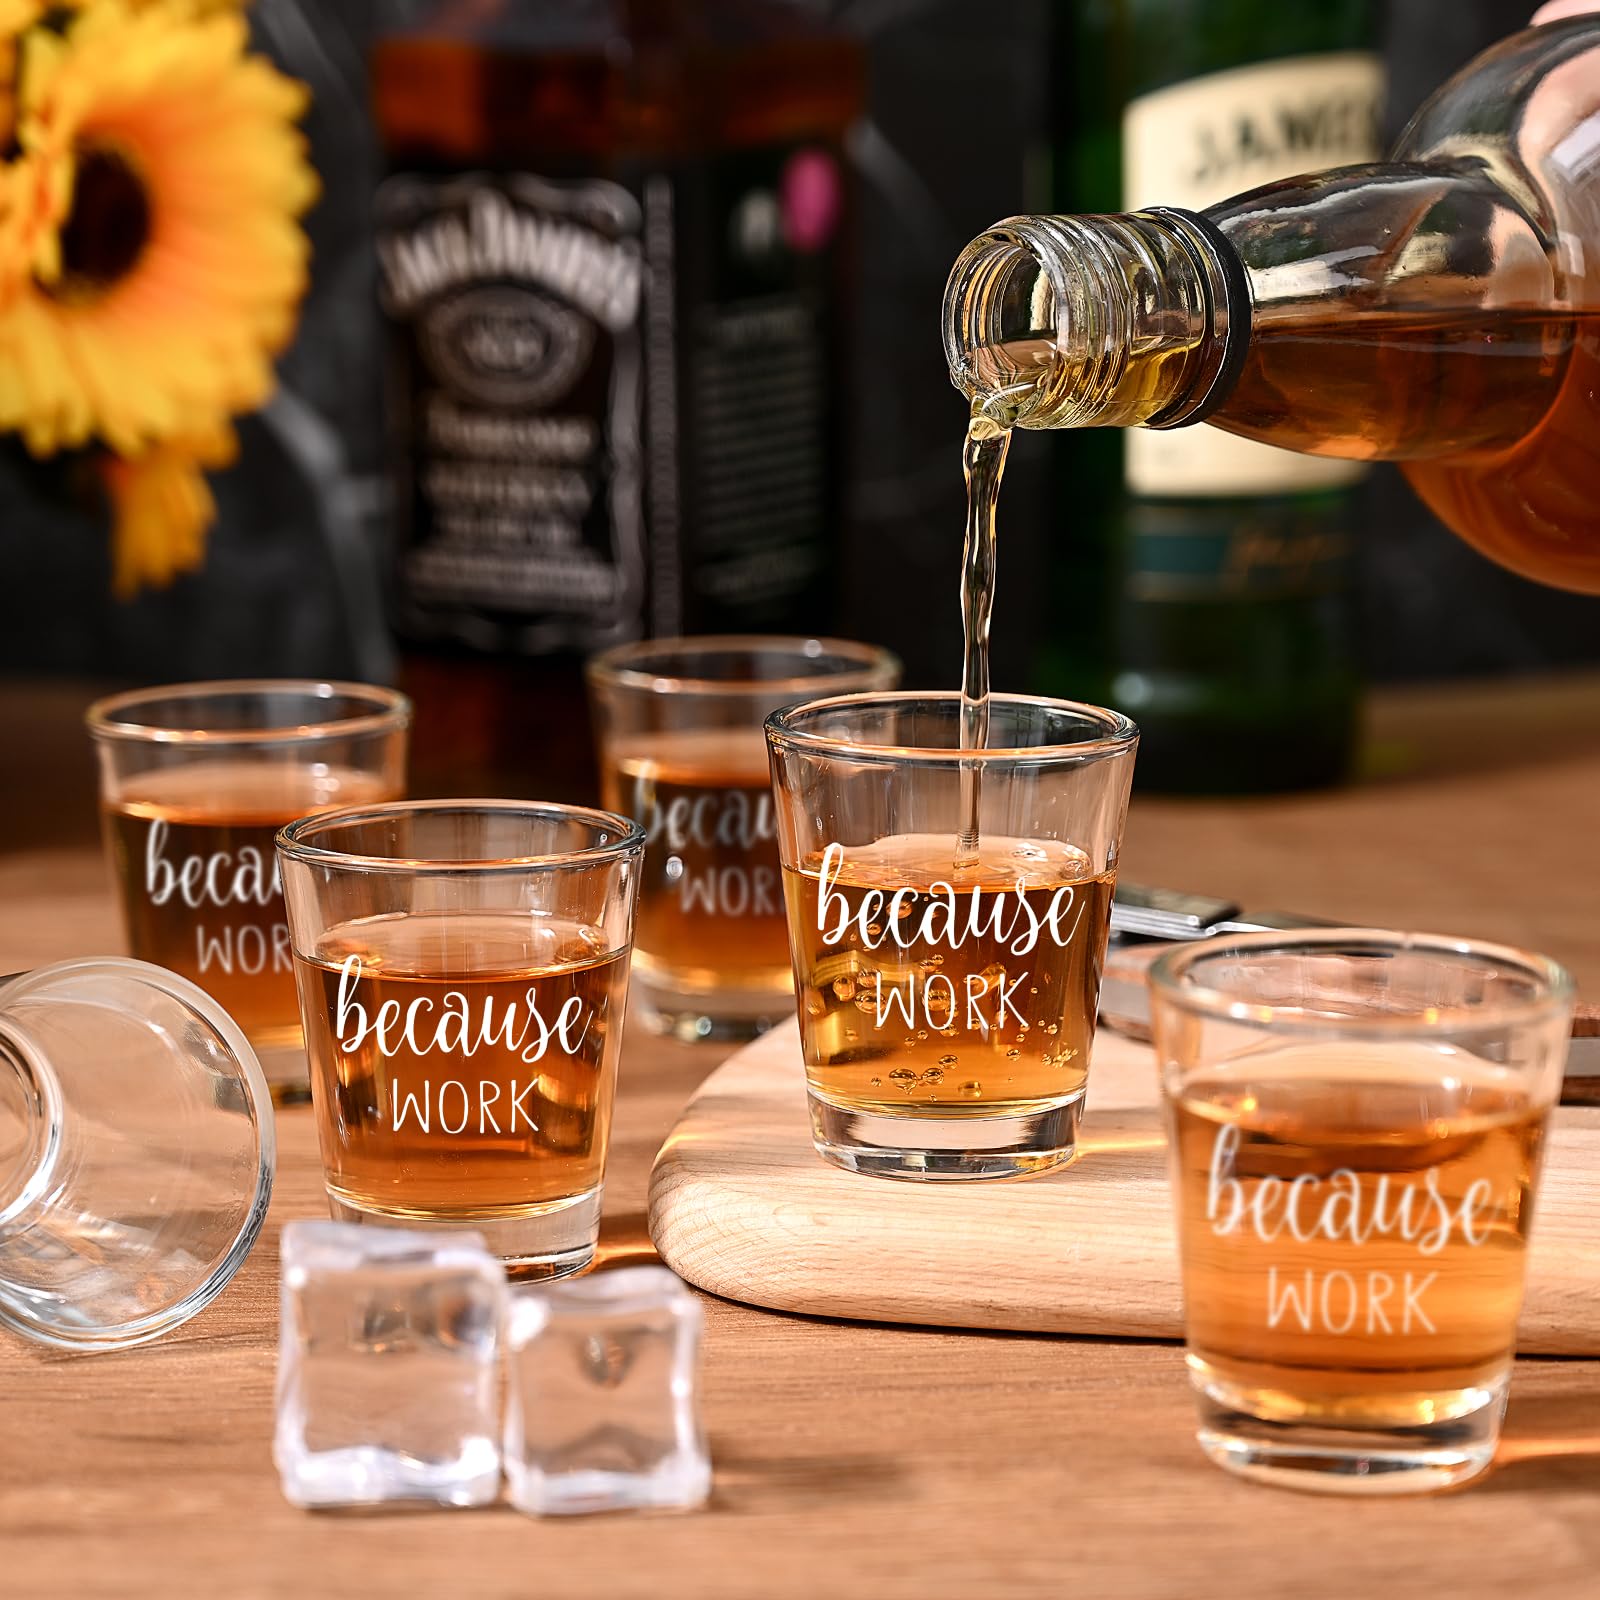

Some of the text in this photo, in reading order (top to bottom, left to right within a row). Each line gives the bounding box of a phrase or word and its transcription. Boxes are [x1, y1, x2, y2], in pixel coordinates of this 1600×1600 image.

[679, 865, 786, 917] WOR
[817, 842, 1086, 956] because
[336, 954, 594, 1063] because
[876, 971, 1029, 1031] WORK
[392, 1077, 540, 1134] WORK
[1206, 1123, 1496, 1256] because
[1266, 1266, 1438, 1334] WORK
